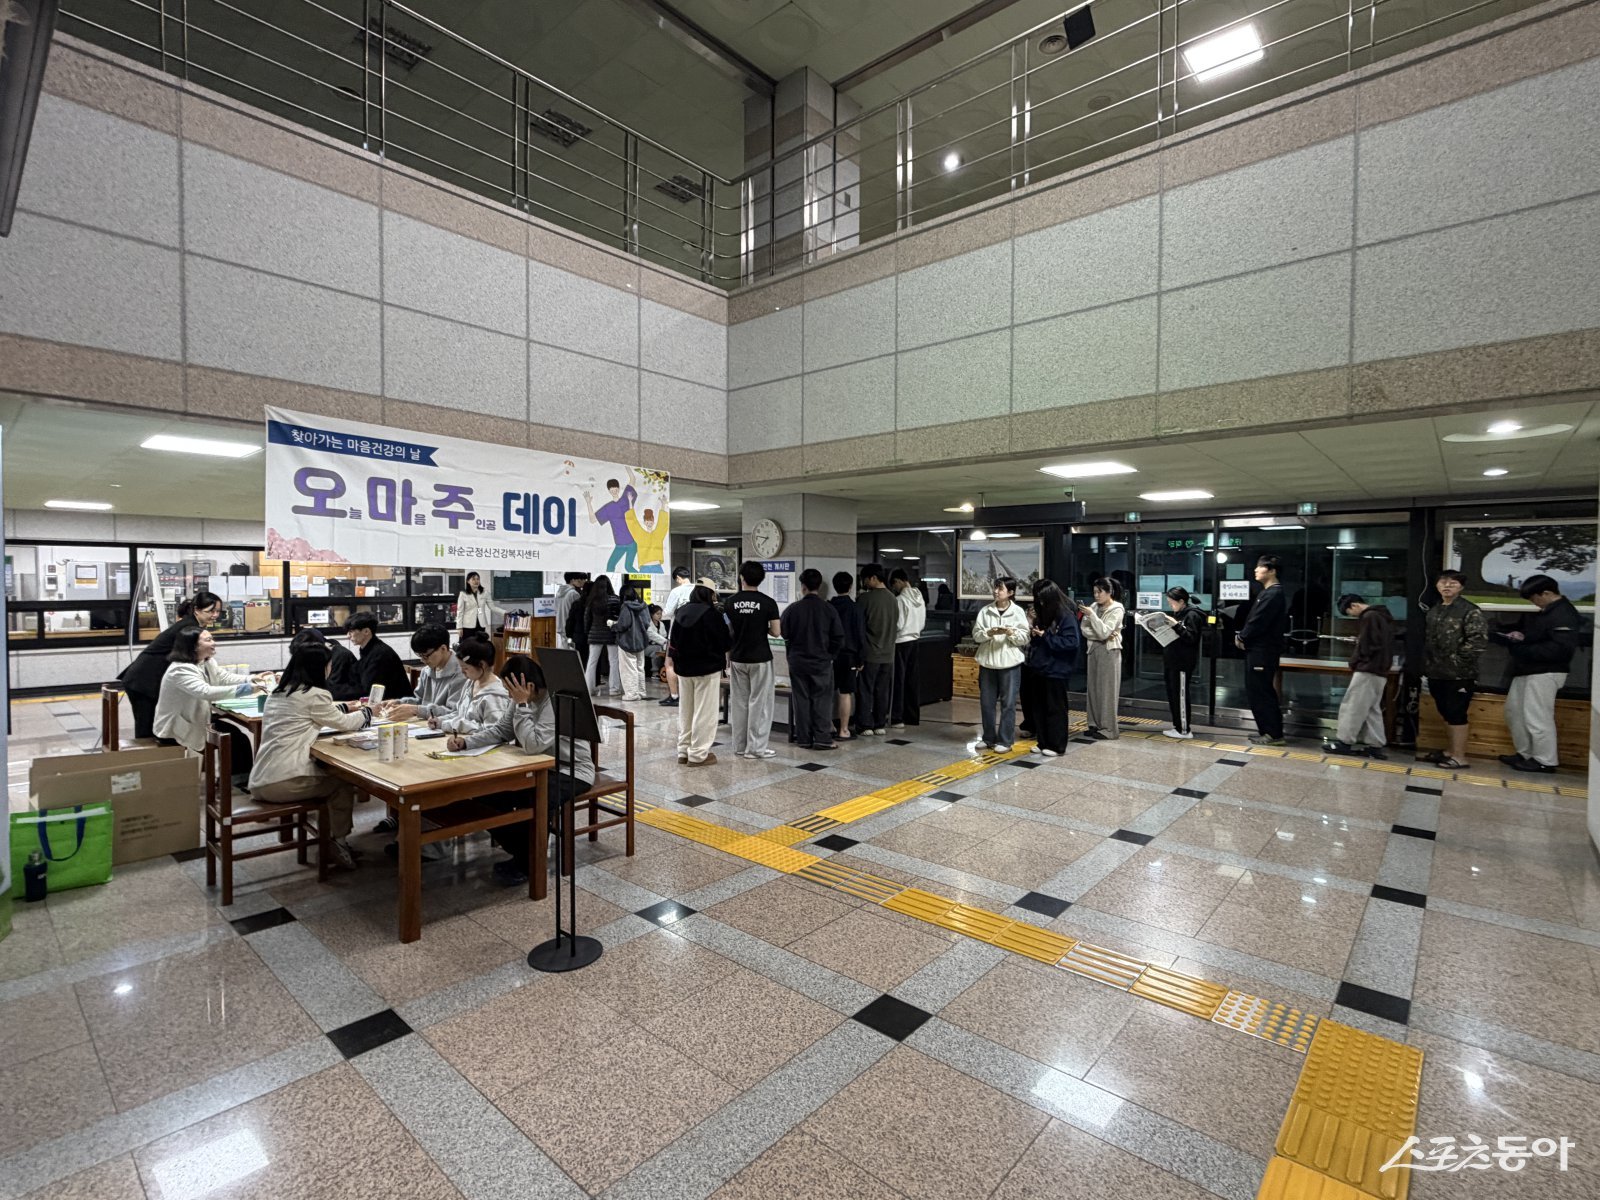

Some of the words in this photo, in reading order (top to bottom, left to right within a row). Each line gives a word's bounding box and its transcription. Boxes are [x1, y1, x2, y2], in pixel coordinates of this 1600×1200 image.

[291, 429, 343, 450] 찾아가는
[347, 439, 406, 459] 마음건강의
[409, 448, 421, 461] 날
[502, 491, 577, 538] 데이
[447, 545, 540, 560] 화순군정신건강복지센터
[733, 601, 761, 610] KOREA
